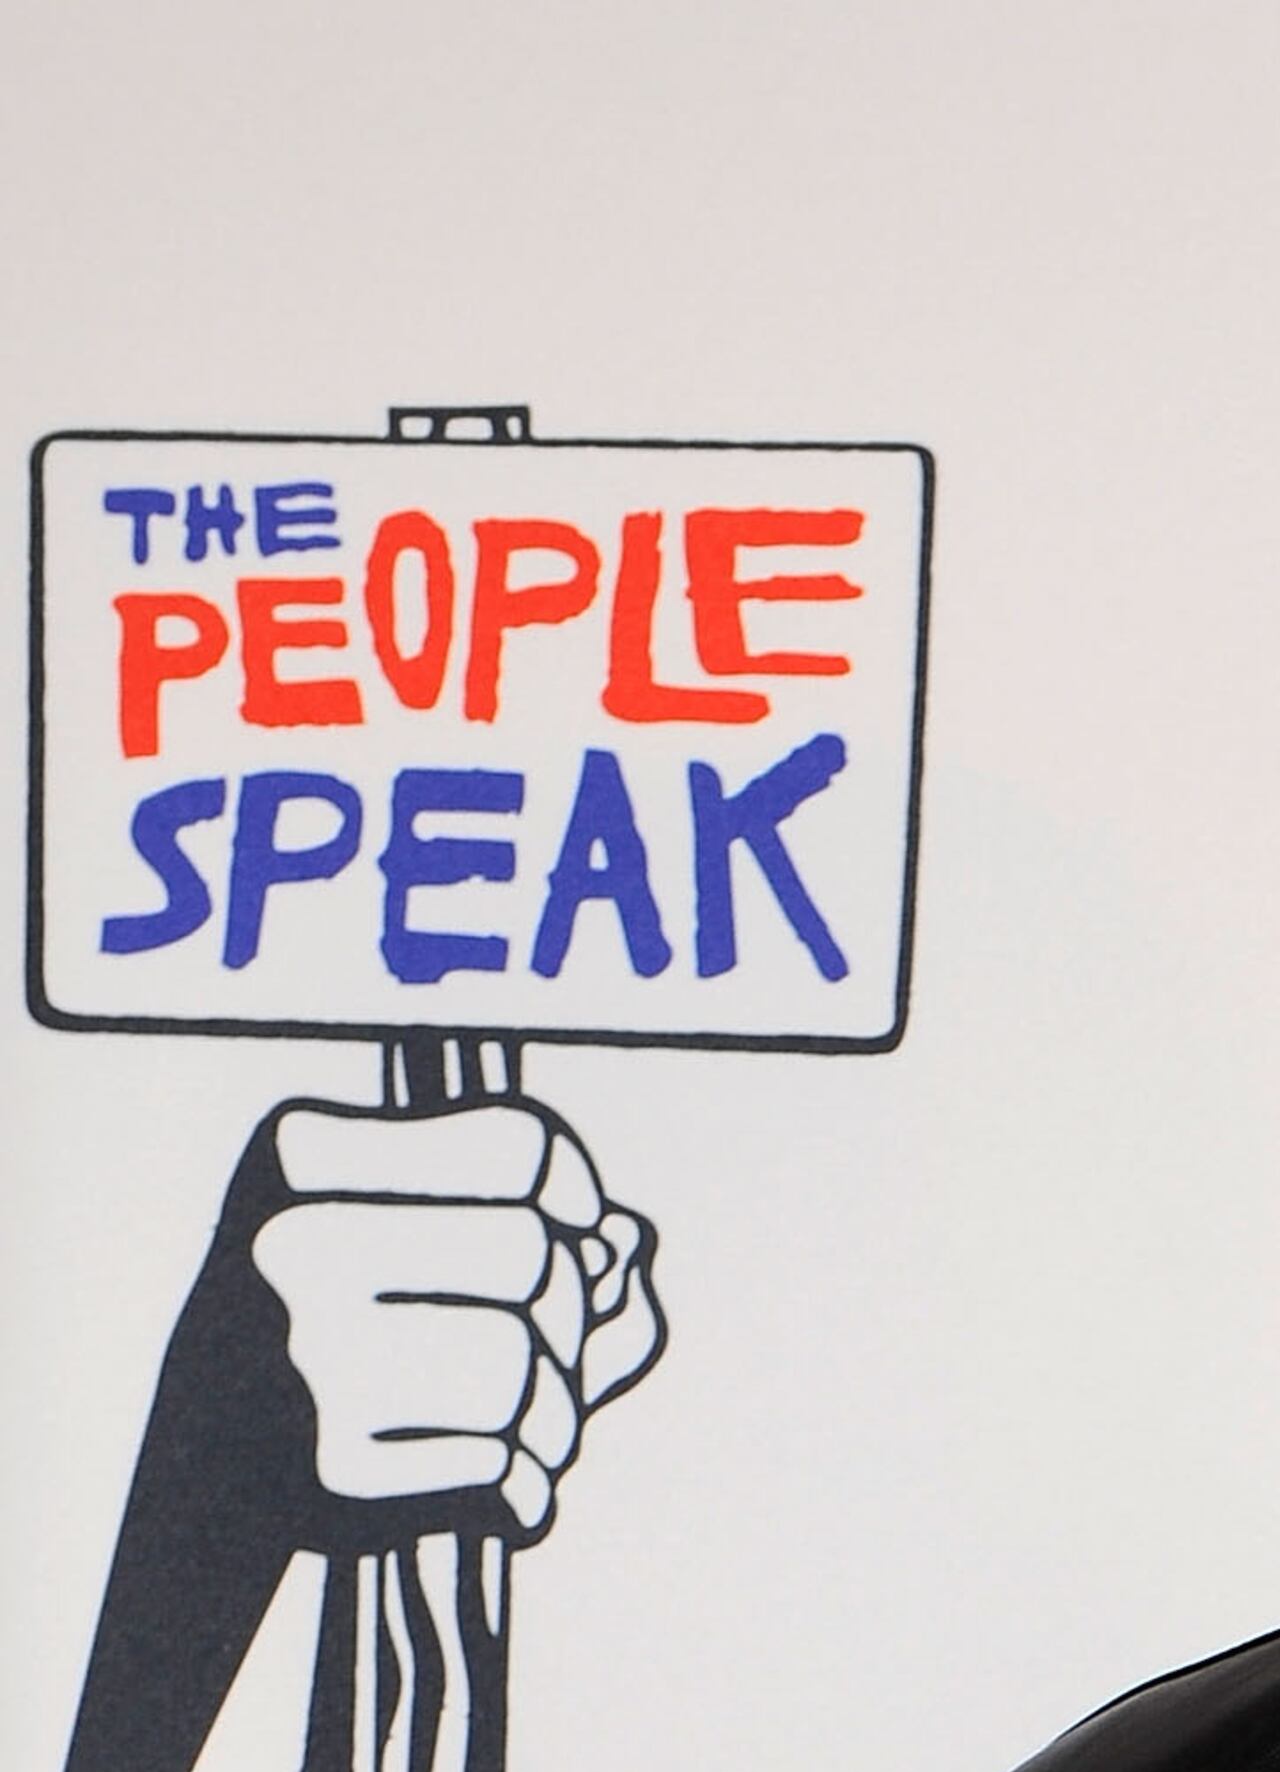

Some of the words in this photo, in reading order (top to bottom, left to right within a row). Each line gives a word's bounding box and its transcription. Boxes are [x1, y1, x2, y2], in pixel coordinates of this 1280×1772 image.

[104, 483, 341, 564] THE
[113, 507, 866, 758] PEOPLE
[100, 732, 849, 984] SPEAK
